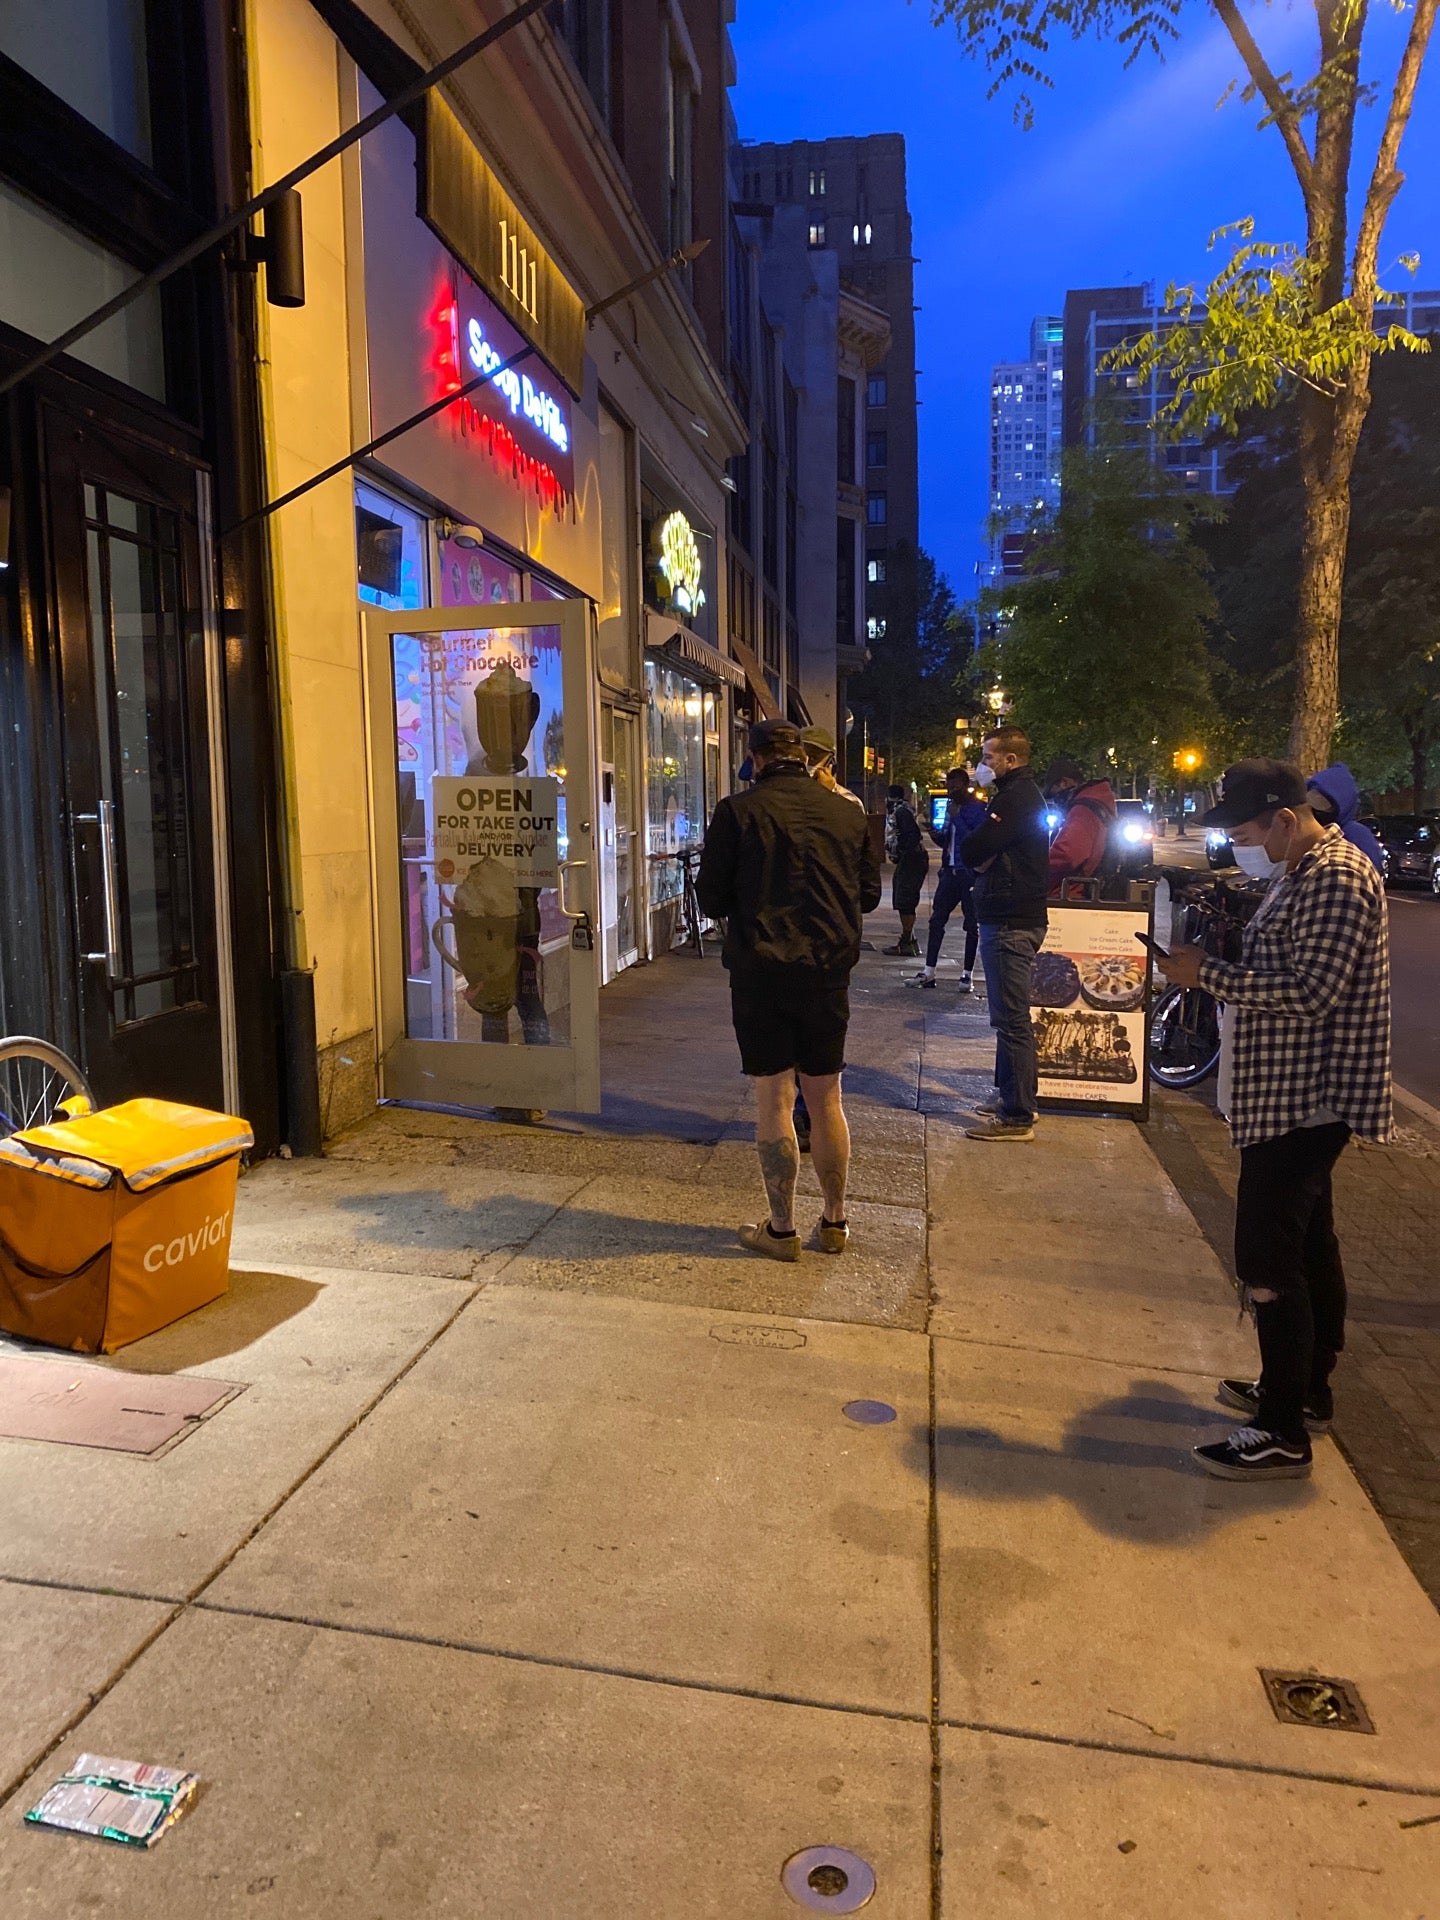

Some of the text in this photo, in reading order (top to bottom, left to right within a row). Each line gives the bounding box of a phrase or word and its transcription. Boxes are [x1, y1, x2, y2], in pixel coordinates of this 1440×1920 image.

[469, 317, 568, 453] Scoop DeVille
[420, 633, 494, 654] Gourmet
[420, 650, 540, 673] Hot Chocolate
[456, 788, 532, 812] OPEN
[437, 815, 554, 831] FOR TAKE OUT
[479, 832, 512, 841] AND/OR
[456, 843, 536, 857] DELIVERY
[1062, 1080, 1075, 1088] the
[1084, 1092, 1108, 1100] CAKES
[143, 1210, 230, 1272] caviar
